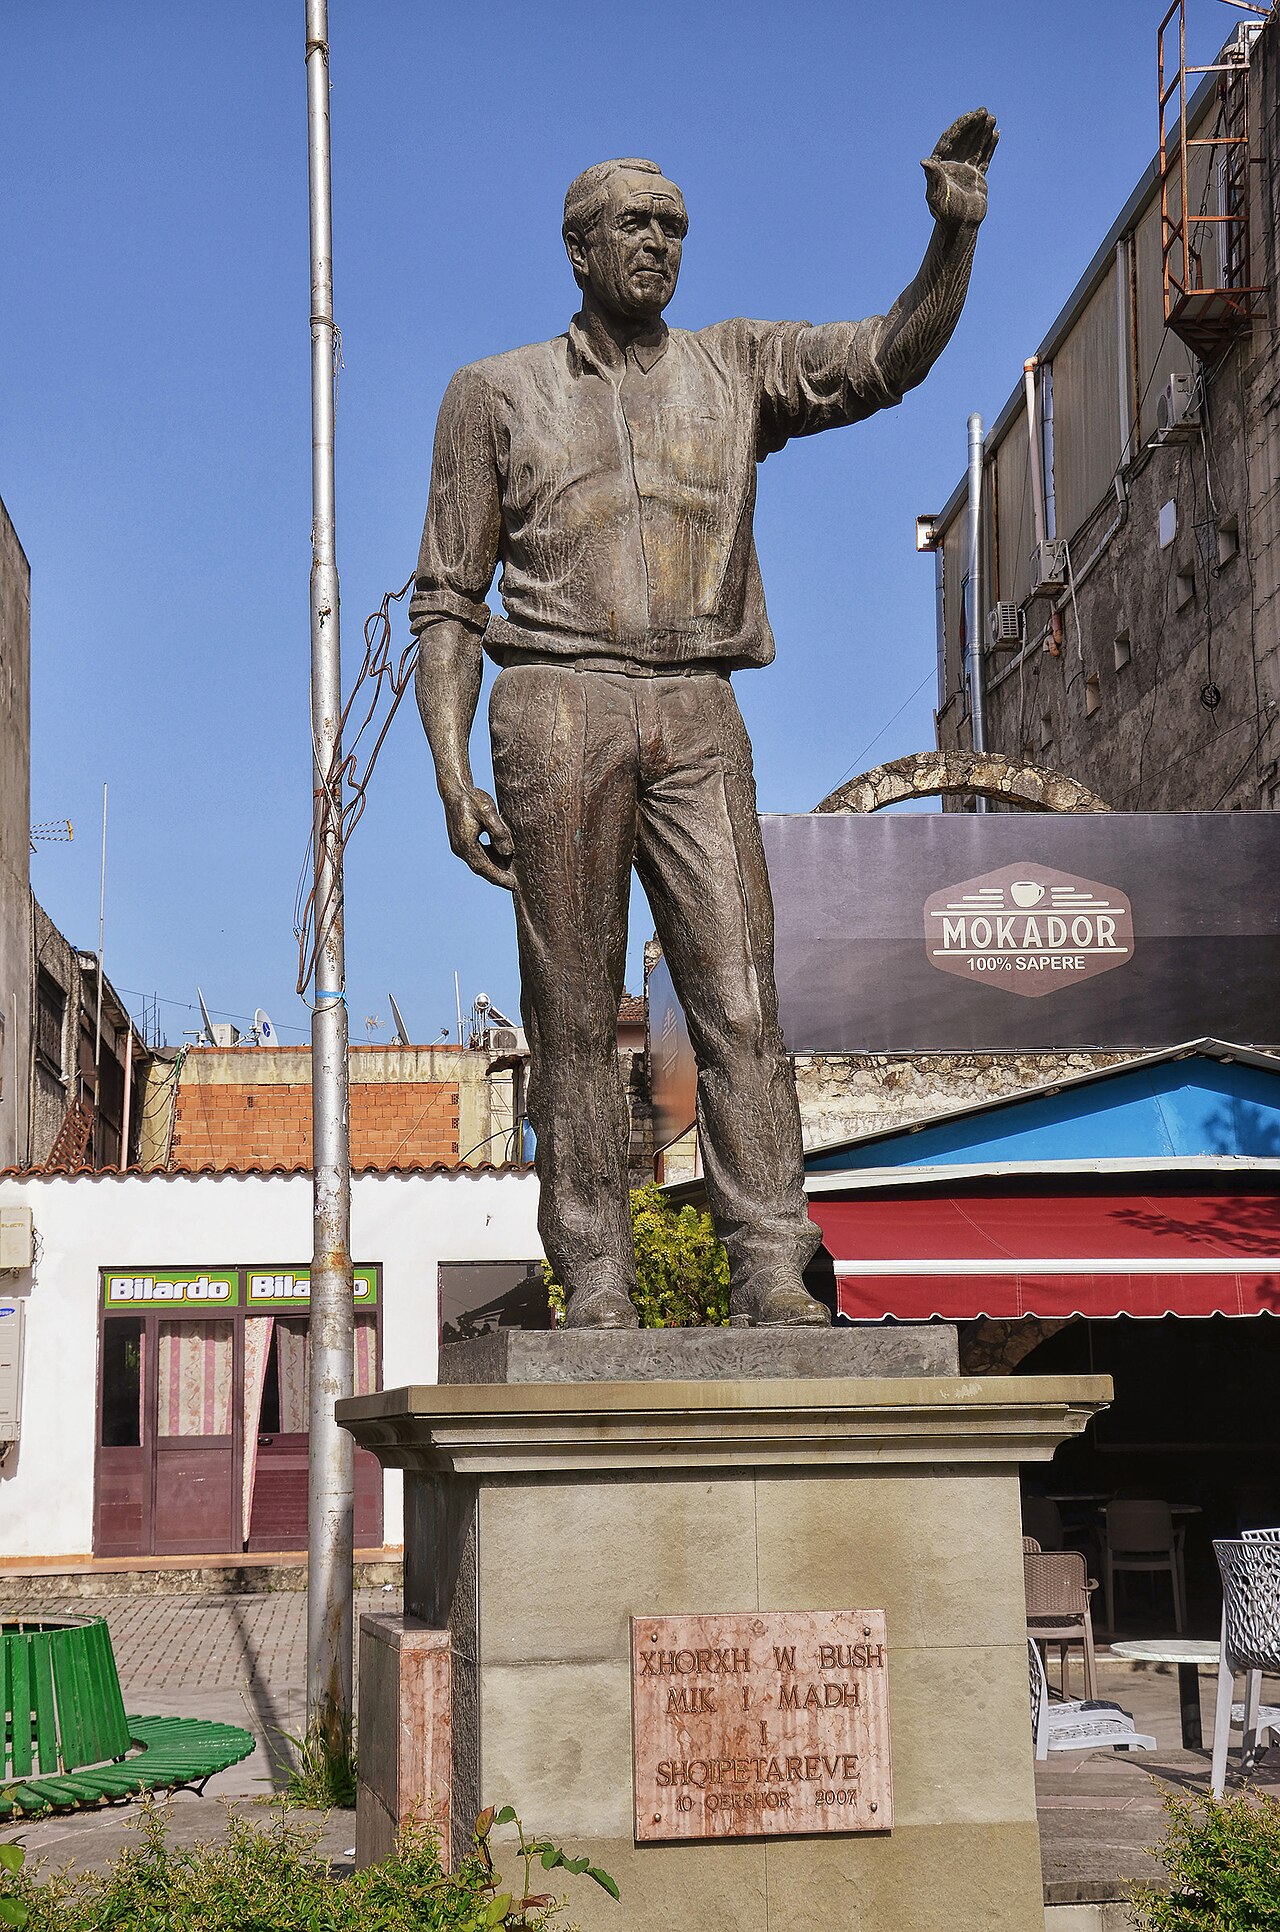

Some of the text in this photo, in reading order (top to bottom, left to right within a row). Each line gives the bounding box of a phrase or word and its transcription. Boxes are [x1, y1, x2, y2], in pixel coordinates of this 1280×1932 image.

[942, 915, 1117, 949] MOKADOR
[966, 956, 1086, 972] 100% SAPERE
[109, 1276, 231, 1300] Bilardo
[251, 1275, 369, 1299] Bilao
[640, 1643, 884, 1676] XHORXH W BUSH
[666, 1682, 862, 1714] MIK I MADH
[760, 1720, 768, 1745] I
[655, 1754, 862, 1789] SHQIPETAREVE
[675, 1788, 858, 1813] 10 QERSHOR 2007
